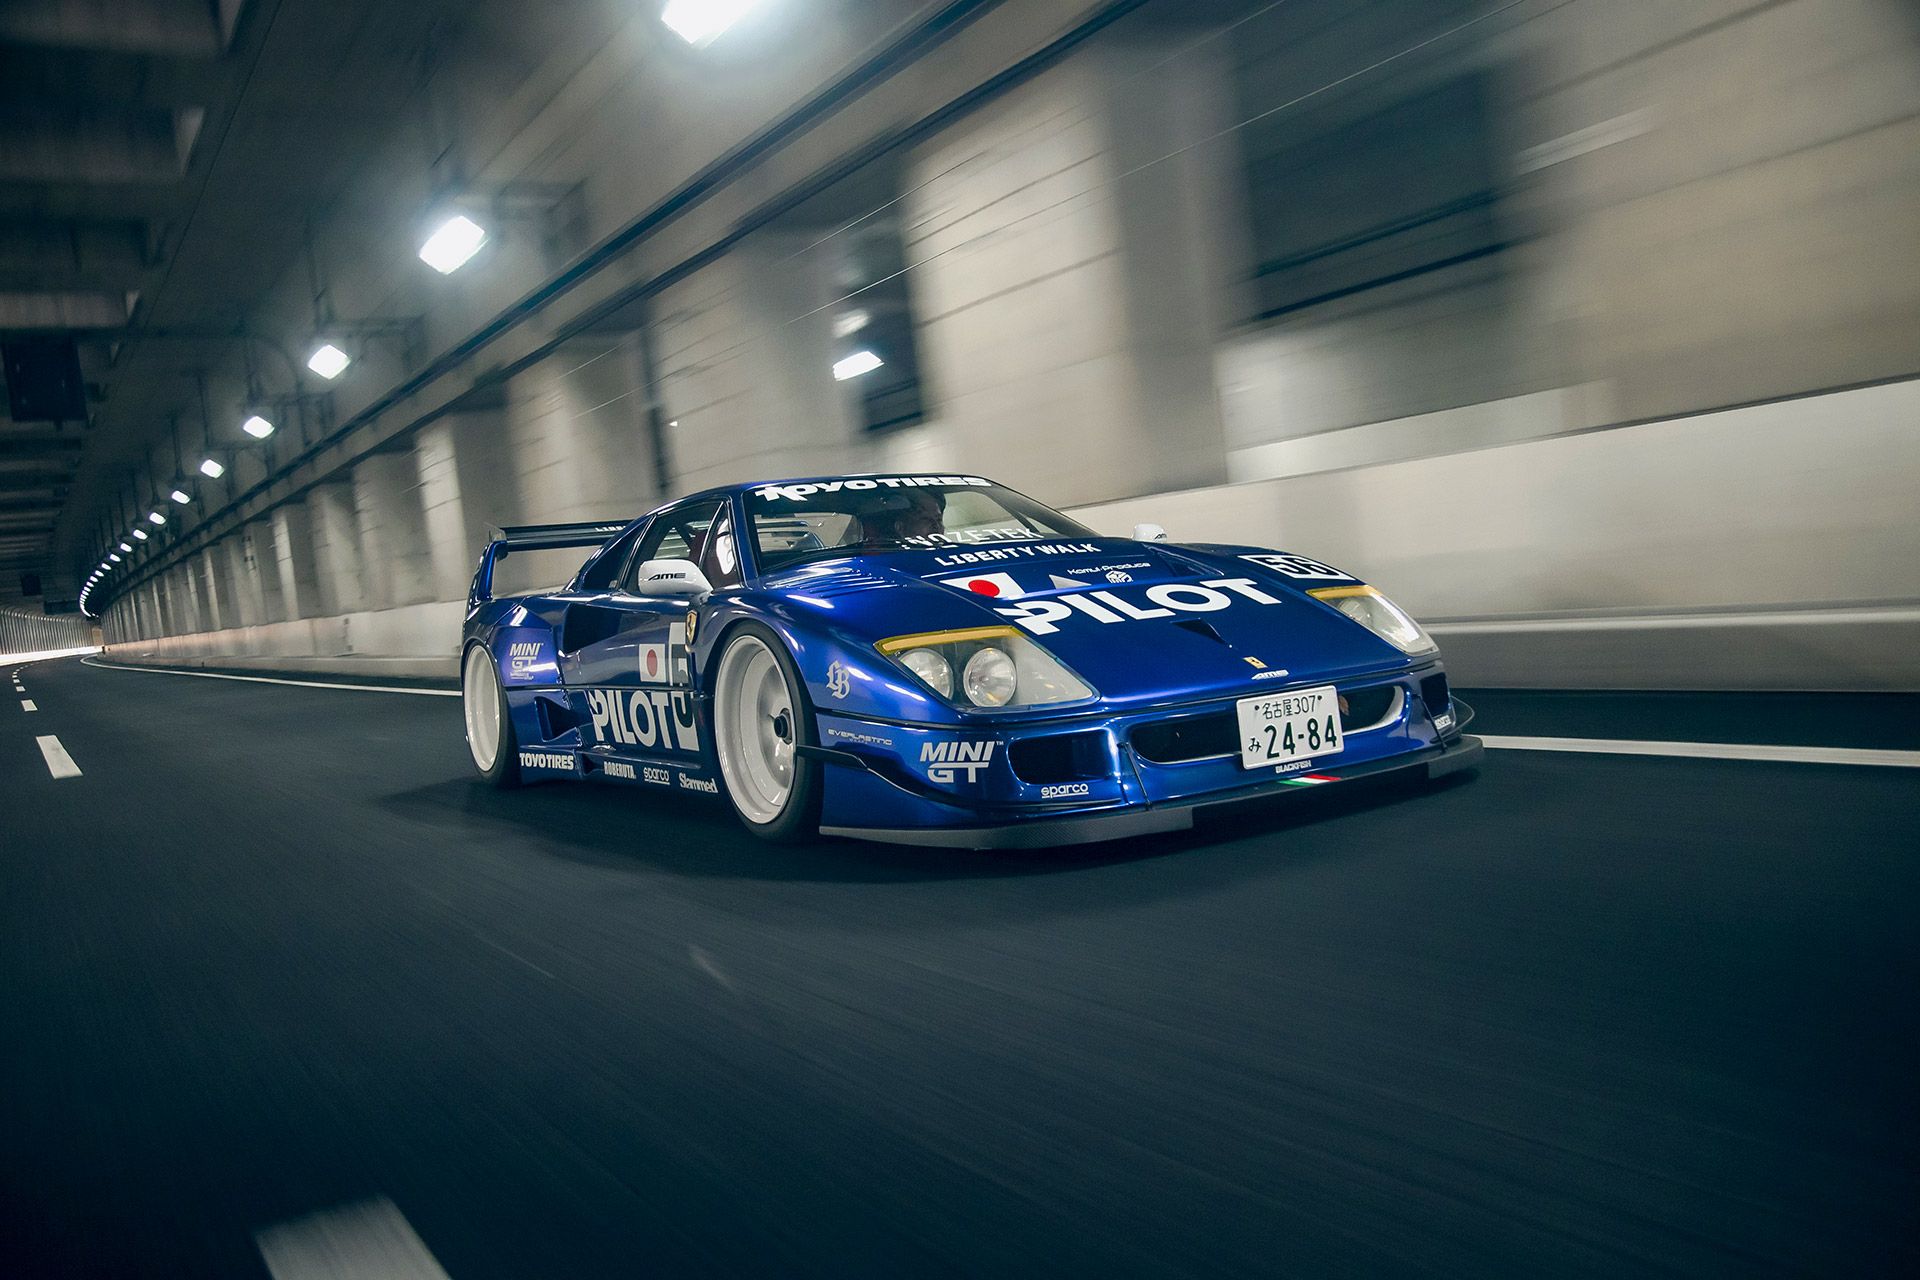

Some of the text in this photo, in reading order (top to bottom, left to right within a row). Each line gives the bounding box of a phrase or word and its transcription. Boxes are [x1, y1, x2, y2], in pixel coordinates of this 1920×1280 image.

[934, 543, 1102, 567] LIBERTY WALK
[992, 578, 1283, 636] PILOT
[509, 642, 541, 657] MINI
[587, 689, 673, 749] PILOT
[1262, 695, 1316, 720] 名古屋307
[1248, 714, 1337, 760] み 24-84
[519, 752, 574, 770] TOYO TIRES
[919, 740, 995, 763] MINI
[643, 767, 670, 785] sparco
[679, 772, 719, 794] Slammed
[927, 761, 990, 784] GT
[1040, 782, 1089, 799] sparco
